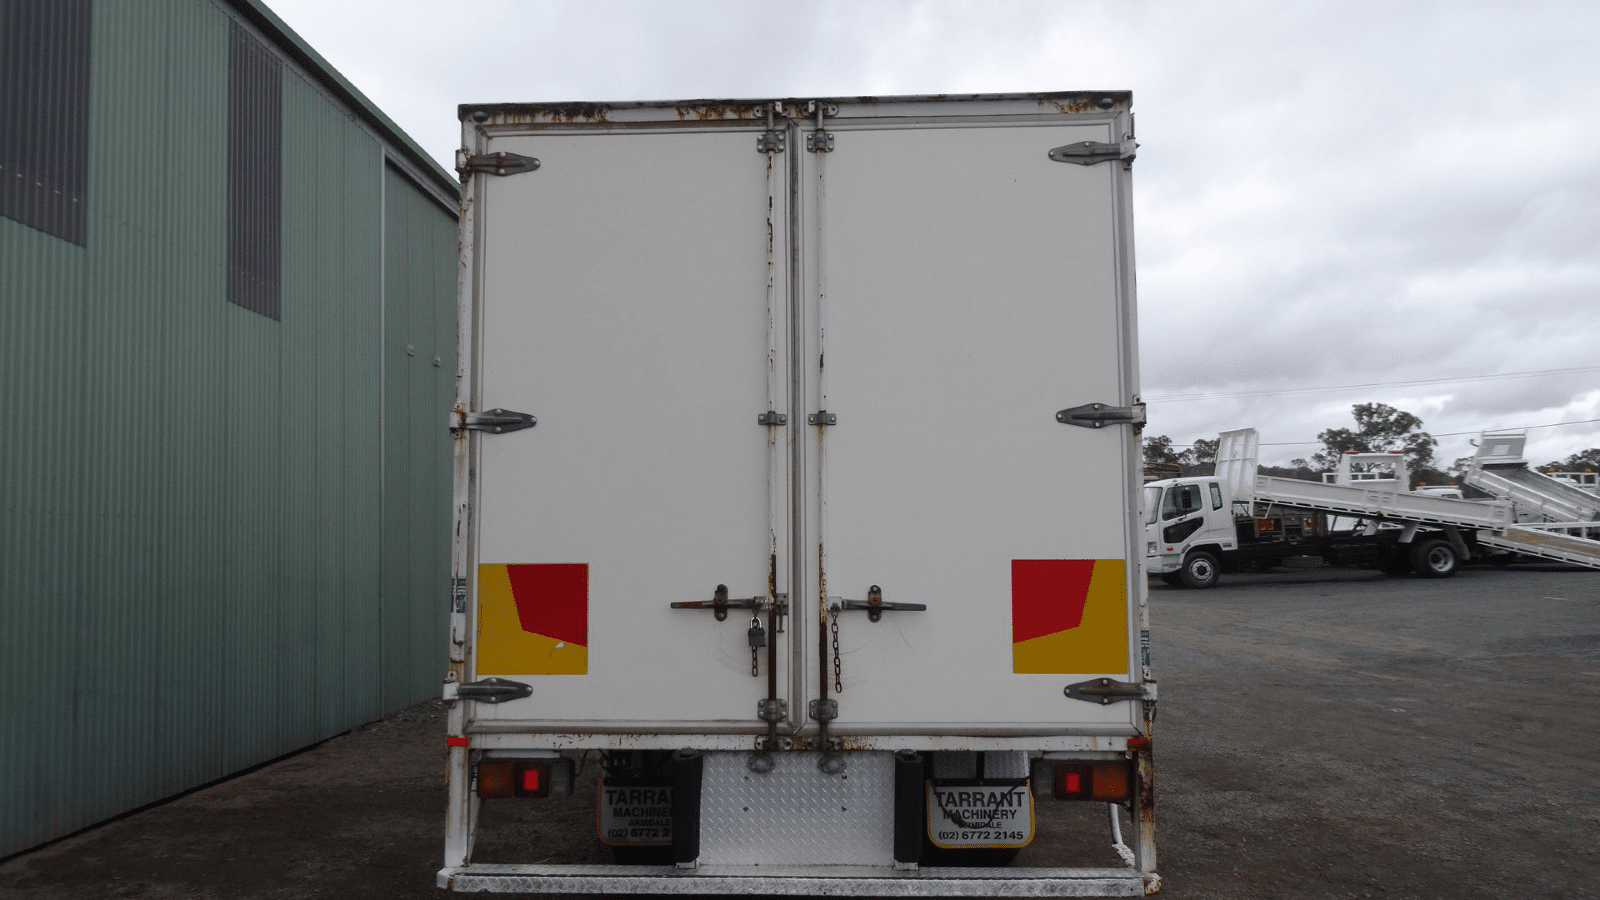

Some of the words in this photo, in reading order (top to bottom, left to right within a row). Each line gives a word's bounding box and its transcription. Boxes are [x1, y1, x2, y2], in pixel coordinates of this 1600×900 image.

[606, 790, 668, 805] TARRA
[937, 792, 1025, 807] TARRANT
[613, 807, 670, 818] MACHINE
[943, 809, 1017, 819] MACHINERY
[608, 828, 628, 838] (02)
[630, 828, 659, 838] 6772
[939, 831, 959, 840] (02)
[962, 831, 990, 840] 6772
[994, 831, 1024, 840] 2145
